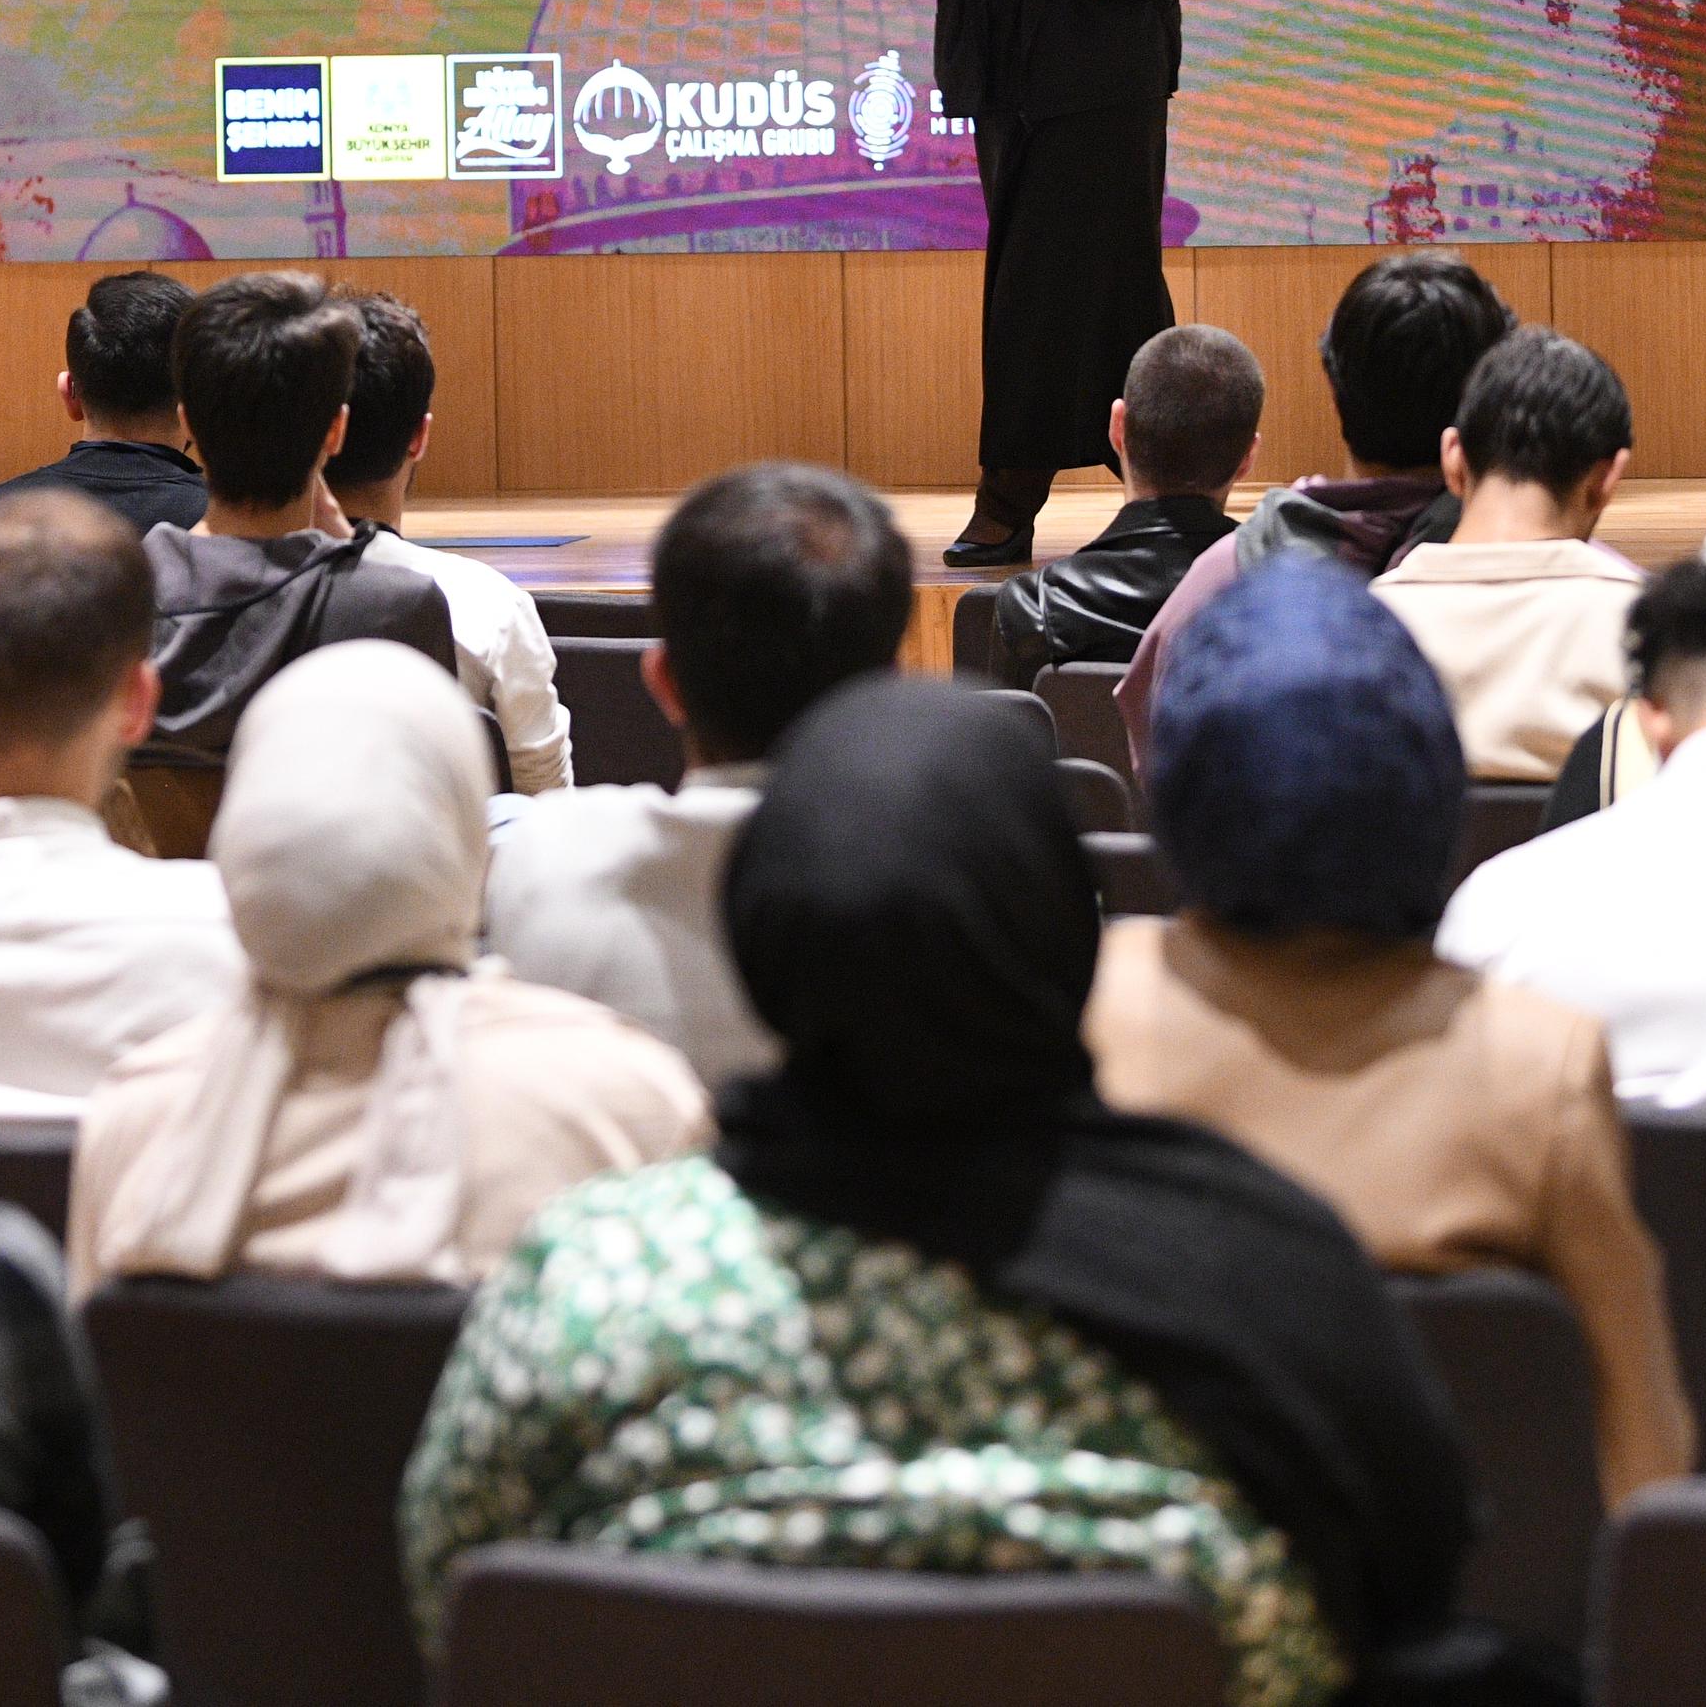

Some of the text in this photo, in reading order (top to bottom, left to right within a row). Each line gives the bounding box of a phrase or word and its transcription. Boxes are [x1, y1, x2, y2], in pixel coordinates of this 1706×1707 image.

[665, 69, 836, 129] KUDÜS
[665, 126, 835, 163] ÇALIŞMA GRUBU
